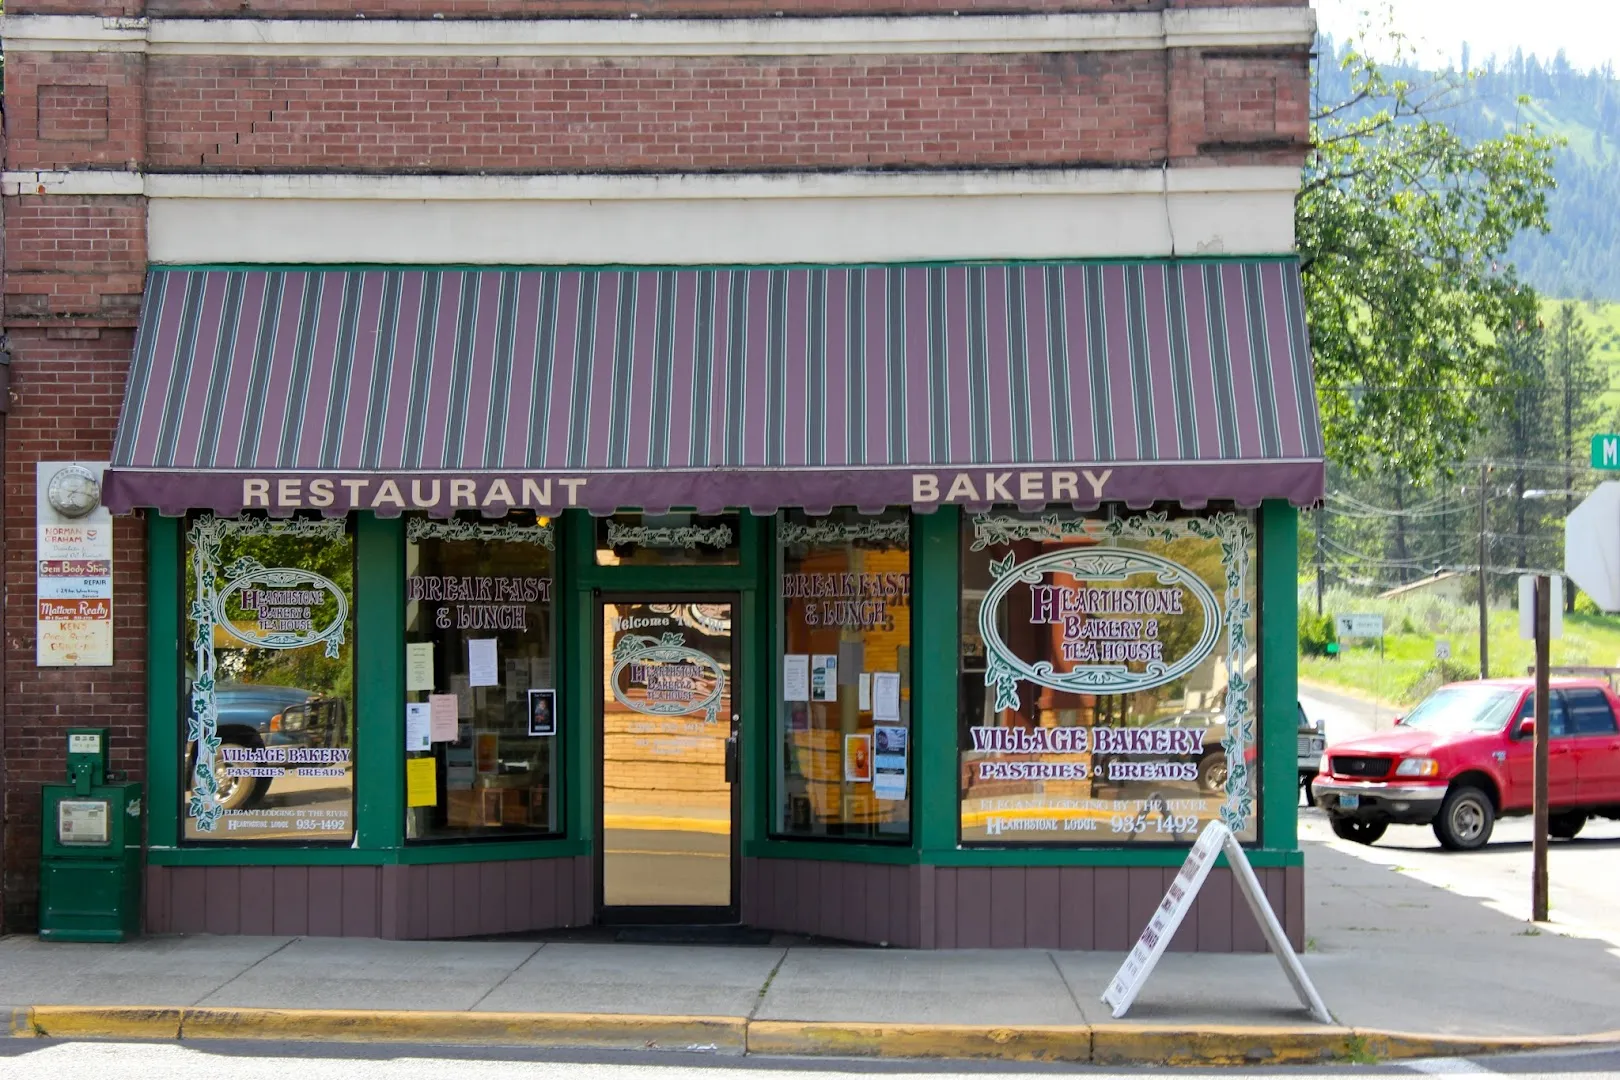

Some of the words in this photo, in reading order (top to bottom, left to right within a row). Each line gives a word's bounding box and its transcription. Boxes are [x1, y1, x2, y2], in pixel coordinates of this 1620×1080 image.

[242, 478, 587, 508] RESTAURANT
[911, 469, 1113, 503] BAKERY
[45, 527, 83, 535] NORMAN
[62, 560, 85, 575] Body
[86, 560, 108, 575] Shop
[408, 575, 552, 602] BREAKFAST
[780, 571, 910, 598] BREAKFAST
[241, 588, 324, 611] HEARTHSTONE
[1030, 584, 1183, 624] HEARTHSTONE
[41, 602, 77, 616] Mattoon
[79, 600, 108, 619] Realty
[259, 604, 302, 620] BAKERY
[435, 607, 451, 629] &
[456, 604, 527, 630] LUNCH
[805, 603, 819, 626] &
[823, 600, 887, 626] LUNCH
[611, 615, 670, 632] Welcome
[1063, 614, 1142, 640] BAKERY
[1145, 619, 1158, 638] &
[1101, 641, 1163, 661] HOUSE
[970, 726, 1088, 753] VILLAGE
[1092, 727, 1208, 754] BAKERY
[222, 748, 286, 763] VILLAGE
[288, 748, 351, 763] BAKERY
[226, 767, 285, 778] PASTRIES
[298, 767, 346, 778] BREADS
[979, 762, 1087, 780] PASTRIES
[1109, 763, 1198, 780] BREADS
[225, 809, 261, 817] ELEGANT
[1113, 800, 1129, 811] BY
[1134, 800, 1162, 812] THE
[1166, 800, 1207, 811] RIVER
[296, 819, 345, 830] 935-1492
[1111, 814, 1198, 833] 935-1492
